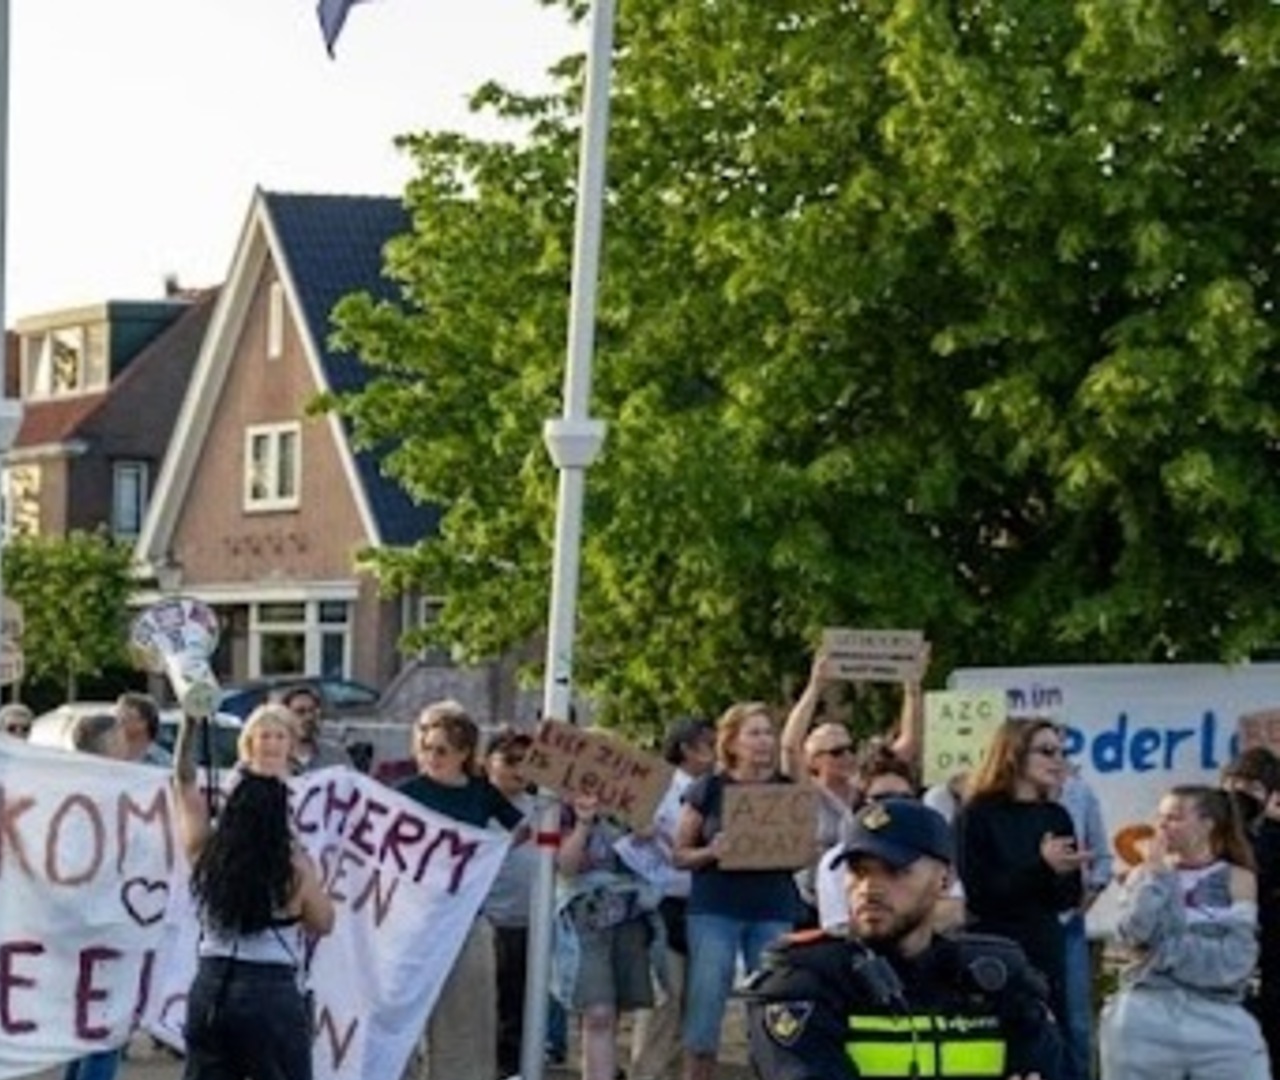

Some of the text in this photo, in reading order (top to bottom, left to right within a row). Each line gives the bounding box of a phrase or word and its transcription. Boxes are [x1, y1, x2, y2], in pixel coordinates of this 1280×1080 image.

[941, 700, 993, 721] AZC
[1062, 711, 1239, 774] ederl
[293, 780, 478, 896] CHERM
